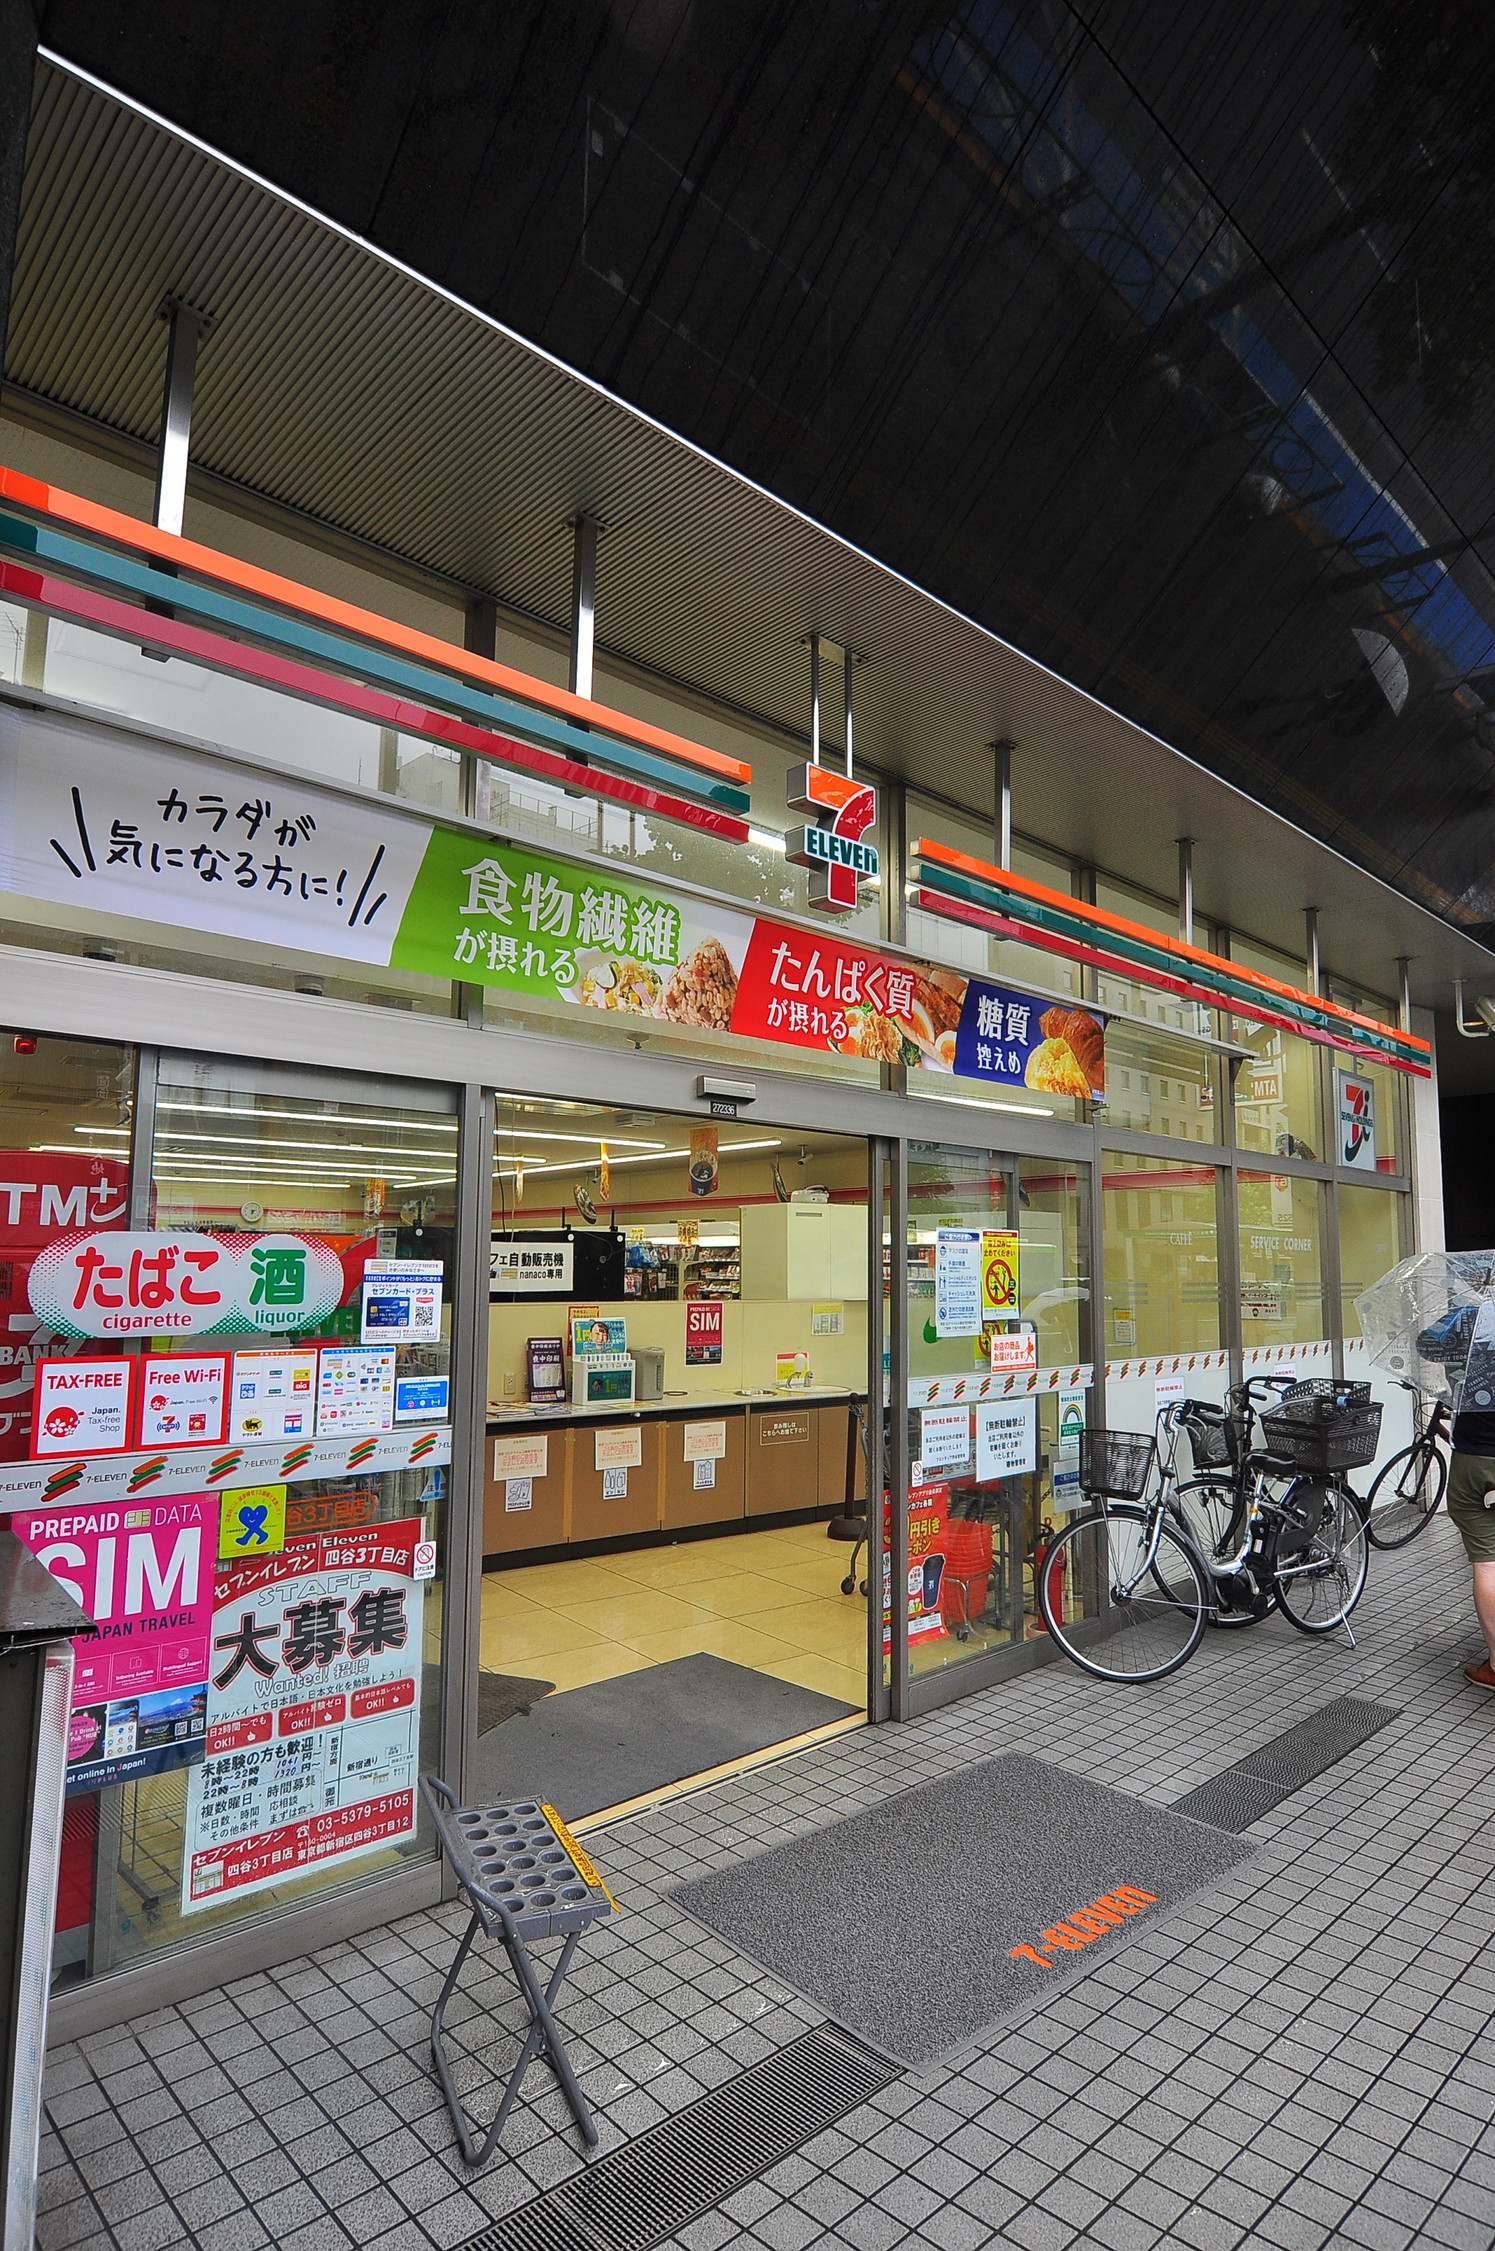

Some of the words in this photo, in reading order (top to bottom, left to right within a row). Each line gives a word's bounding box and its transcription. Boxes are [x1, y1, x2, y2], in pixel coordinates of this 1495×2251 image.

[157, 788, 317, 848] カラダが
[105, 819, 348, 908] 気になる方に!
[458, 857, 681, 966] 食物繊維
[454, 927, 578, 986] が摂れる
[769, 941, 915, 1019] たんぱく質
[767, 998, 848, 1042] が摂れる
[977, 995, 1031, 1046] 糖質
[977, 1042, 1021, 1074] 控えめ
[713, 1103, 735, 1115] 272336
[984, 1249, 1016, 1257] 止めてください
[1251, 1236, 1280, 1250] SERVICE
[1284, 1237, 1312, 1251] CORNER
[490, 1252, 564, 1267] フェ自動販売機
[73, 1245, 221, 1310] たばこ
[249, 1247, 307, 1305] 酒
[519, 1269, 563, 1279] nanaco専用
[102, 1311, 192, 1331] cigarette
[255, 1309, 305, 1327] liquor
[690, 1312, 720, 1331] SIM
[994, 1341, 1020, 1351] お店の商品
[47, 1372, 123, 1390] TAX-FREE
[149, 1371, 180, 1385] Free
[184, 1368, 221, 1383] Wi-Fi
[87, 1415, 121, 1425] Tax-free
[91, 1406, 121, 1416] Japan.
[924, 1416, 967, 1426] 無断駐輪禁止
[99, 1423, 121, 1434] Shop
[986, 1415, 1026, 1432] 【無断駐輪禁止】
[30, 1512, 119, 1540] PREPAID
[155, 1503, 202, 1526] DATA
[322, 1532, 378, 1547] Eleven
[325, 1546, 410, 1567] 四谷3丁目店
[35, 1527, 202, 1620] SIM
[214, 1554, 315, 1599] セブンイレブン
[258, 1571, 372, 1607] STAFF
[82, 1622, 133, 1643] JAPAN
[140, 1611, 196, 1633] TRAVEL
[212, 1587, 407, 1691] 大募集
[254, 1665, 330, 1698] Wanted!
[333, 1657, 370, 1680] 招聘
[354, 1683, 411, 1702] 基本的日本語レベルでも
[283, 1698, 342, 1719] アルバイト経験ゼロ
[366, 1697, 385, 1710] OK!!
[291, 1717, 311, 1730] OK!!
[214, 1736, 235, 1750] OK!!
[77, 1768, 105, 1781] online
[107, 1766, 115, 1774] in
[117, 1757, 146, 1772] Japan!
[346, 1756, 378, 1773] 新宿通り
[269, 1796, 299, 1812] 応相談
[194, 1830, 285, 1866] セブンイレブン
[317, 1794, 409, 1833] 03-5379-5105
[210, 1819, 259, 1841] その他条件
[227, 1847, 293, 1876] 四谷3丁目店
[297, 1816, 409, 1861] 東京都新宿区四谷3丁目12
